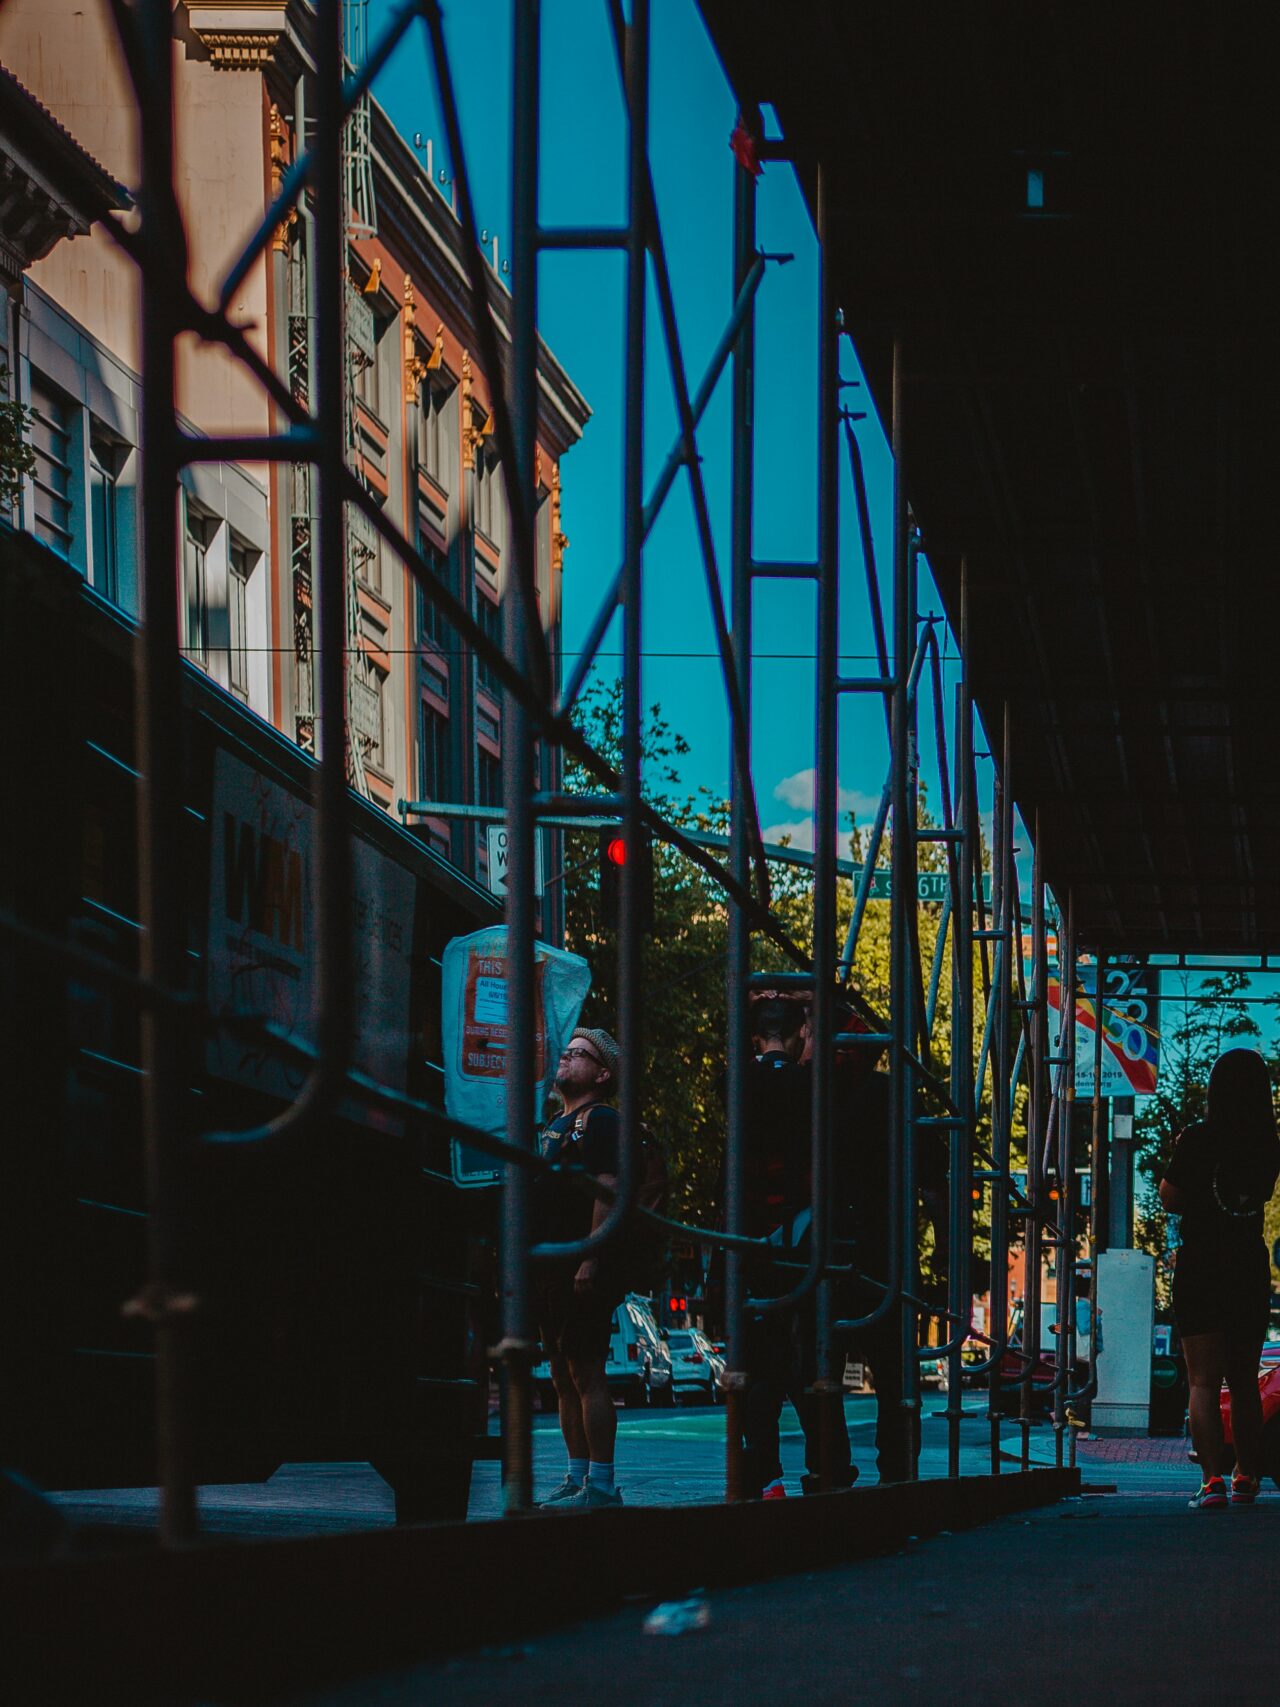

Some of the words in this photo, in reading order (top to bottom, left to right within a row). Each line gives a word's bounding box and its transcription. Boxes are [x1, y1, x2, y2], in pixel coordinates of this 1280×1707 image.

[478, 960, 503, 975] THIS
[490, 981, 508, 991] Hour
[1102, 1071, 1123, 1079] 2019
